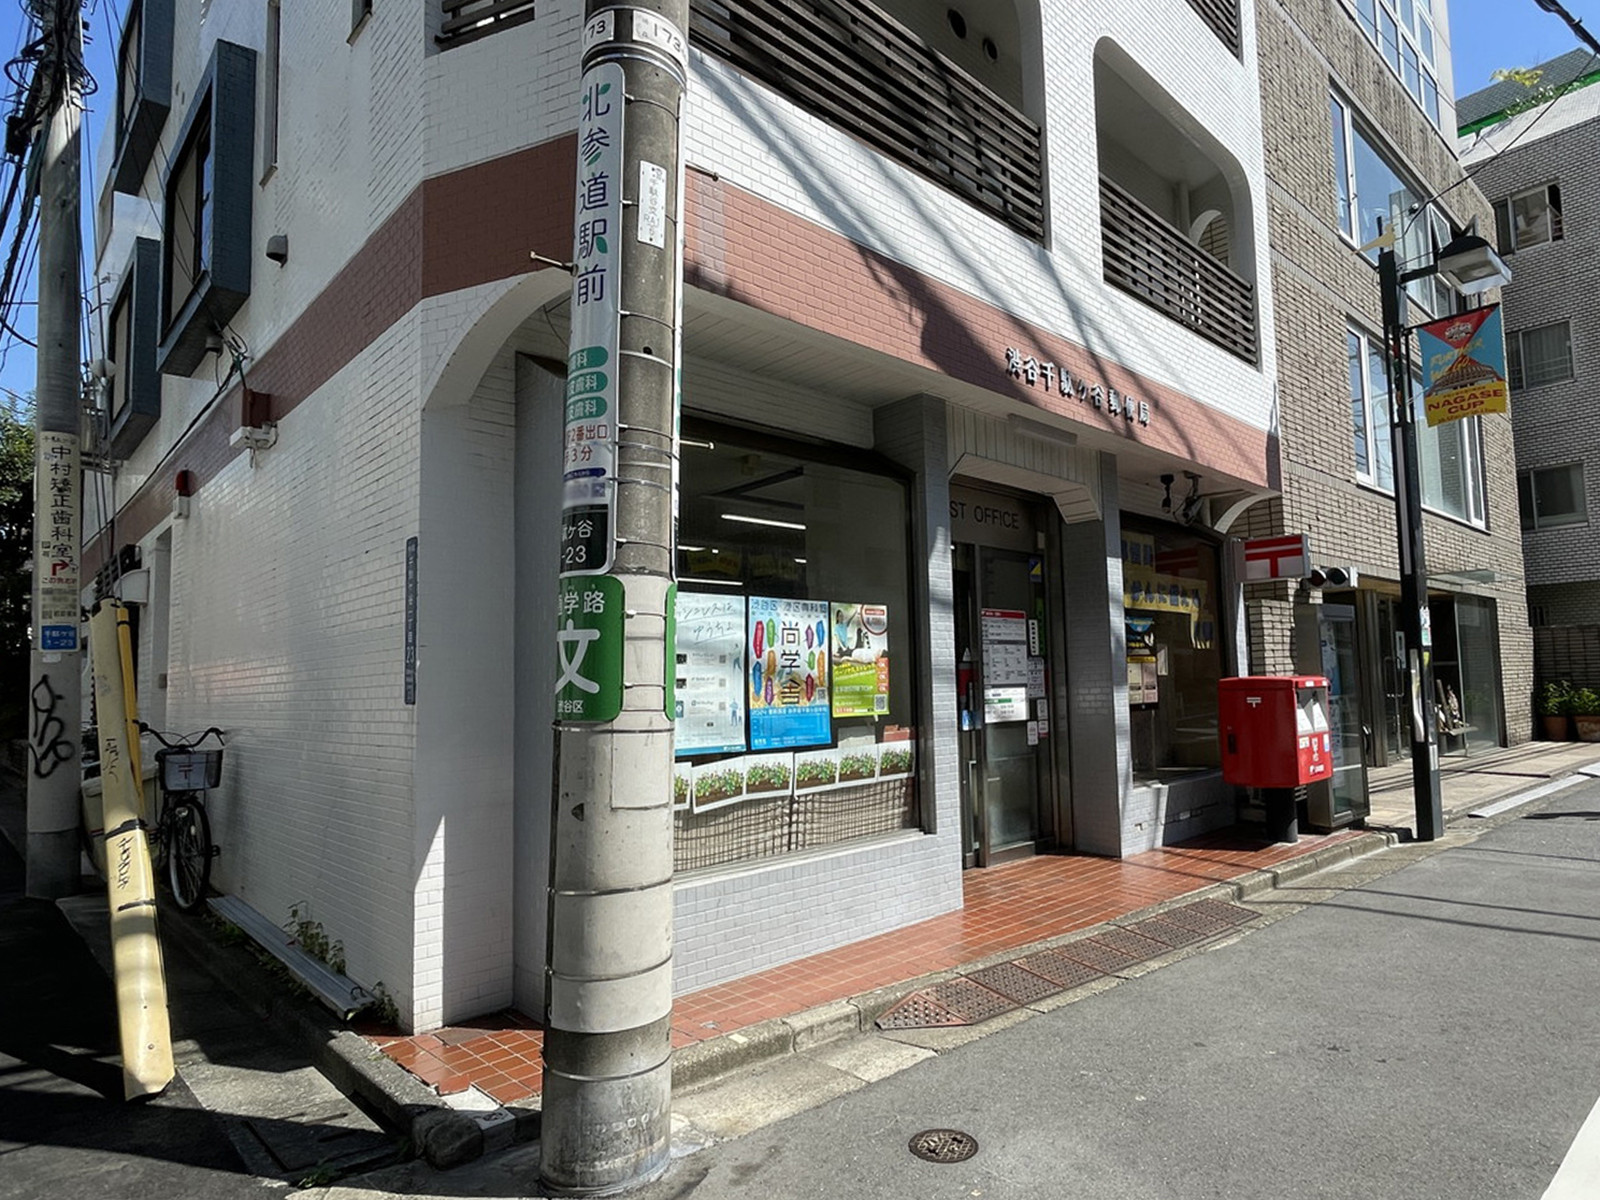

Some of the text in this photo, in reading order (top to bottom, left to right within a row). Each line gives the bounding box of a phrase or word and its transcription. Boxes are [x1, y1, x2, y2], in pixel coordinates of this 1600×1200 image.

[654, 23, 681, 52] 173
[576, 82, 612, 306] 北参道駅前
[1428, 389, 1503, 412] NAGASE
[1448, 401, 1484, 414] CUP
[51, 445, 73, 559] 中村矯正歯科室
[974, 505, 1019, 529] OFFICE
[558, 590, 605, 615] 学路
[781, 620, 801, 704] 尚学舎
